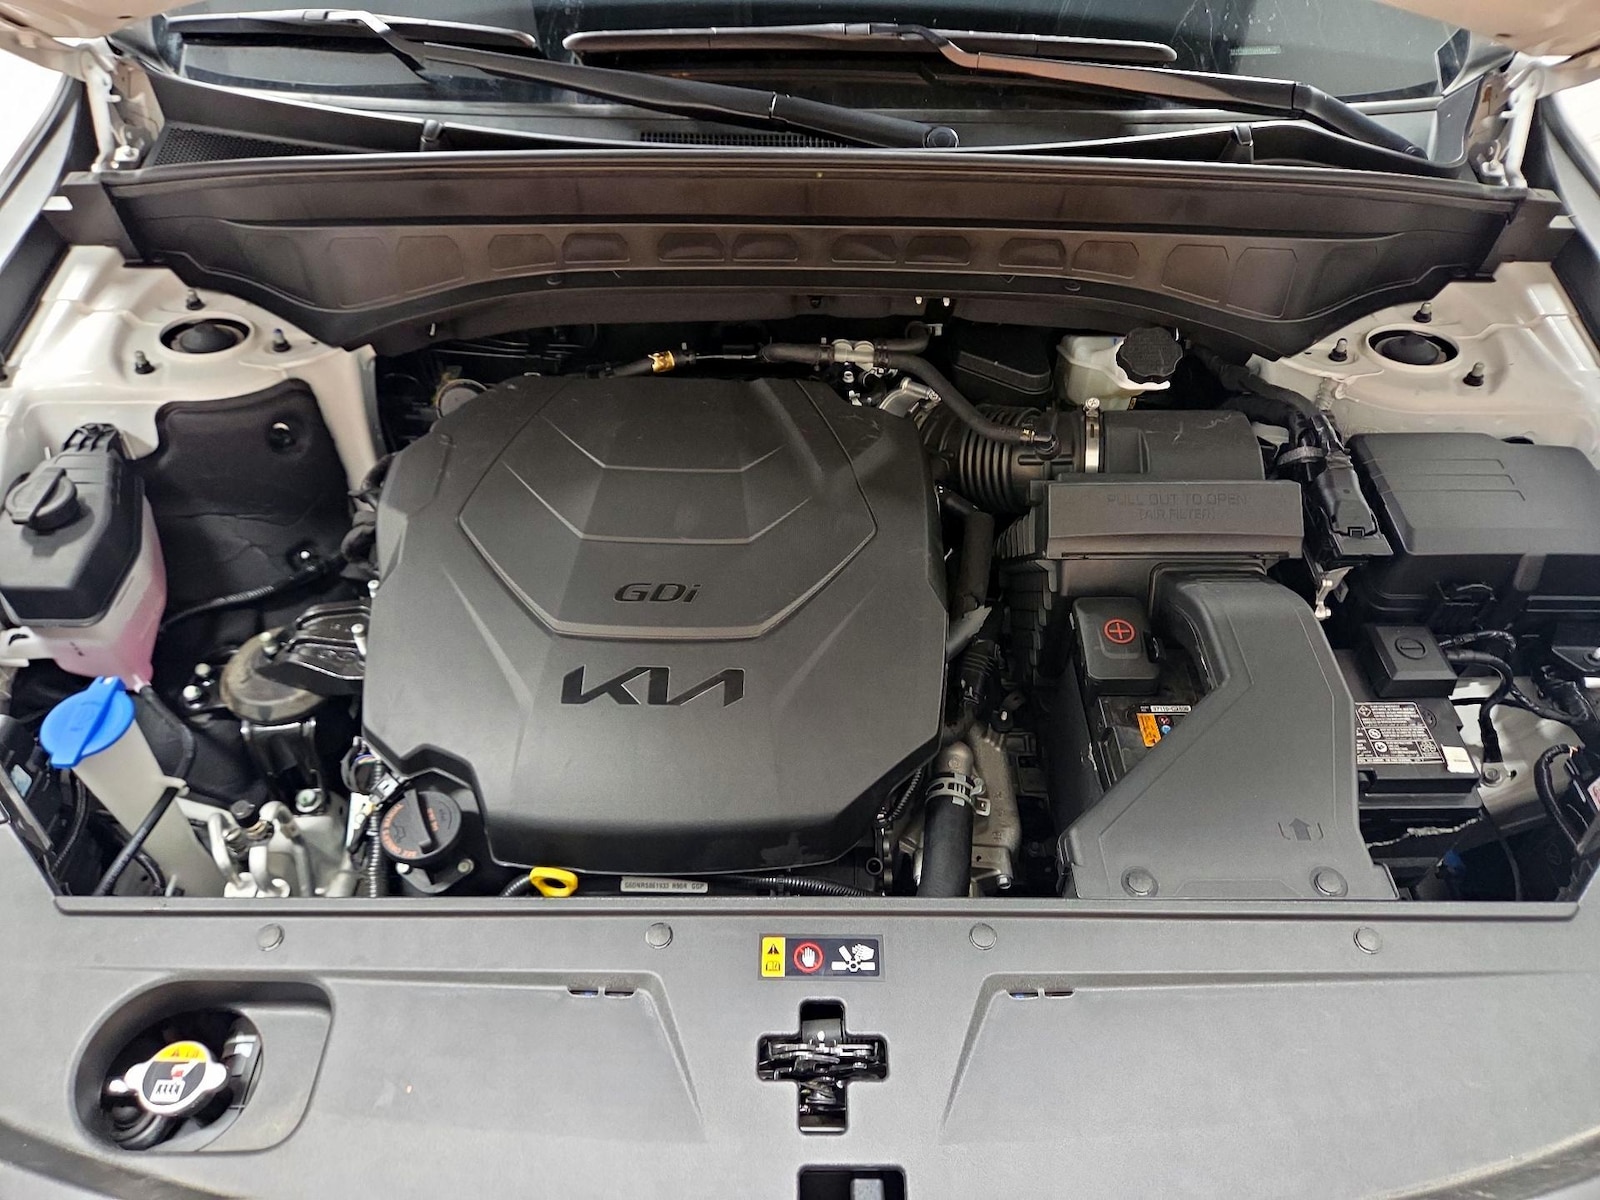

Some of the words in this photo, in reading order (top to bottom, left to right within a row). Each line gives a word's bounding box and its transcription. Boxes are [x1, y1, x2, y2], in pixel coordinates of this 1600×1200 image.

[1149, 493, 1177, 506] OUT
[1182, 493, 1202, 506] TO
[1207, 493, 1246, 506] OPEN
[613, 583, 701, 603] GDi
